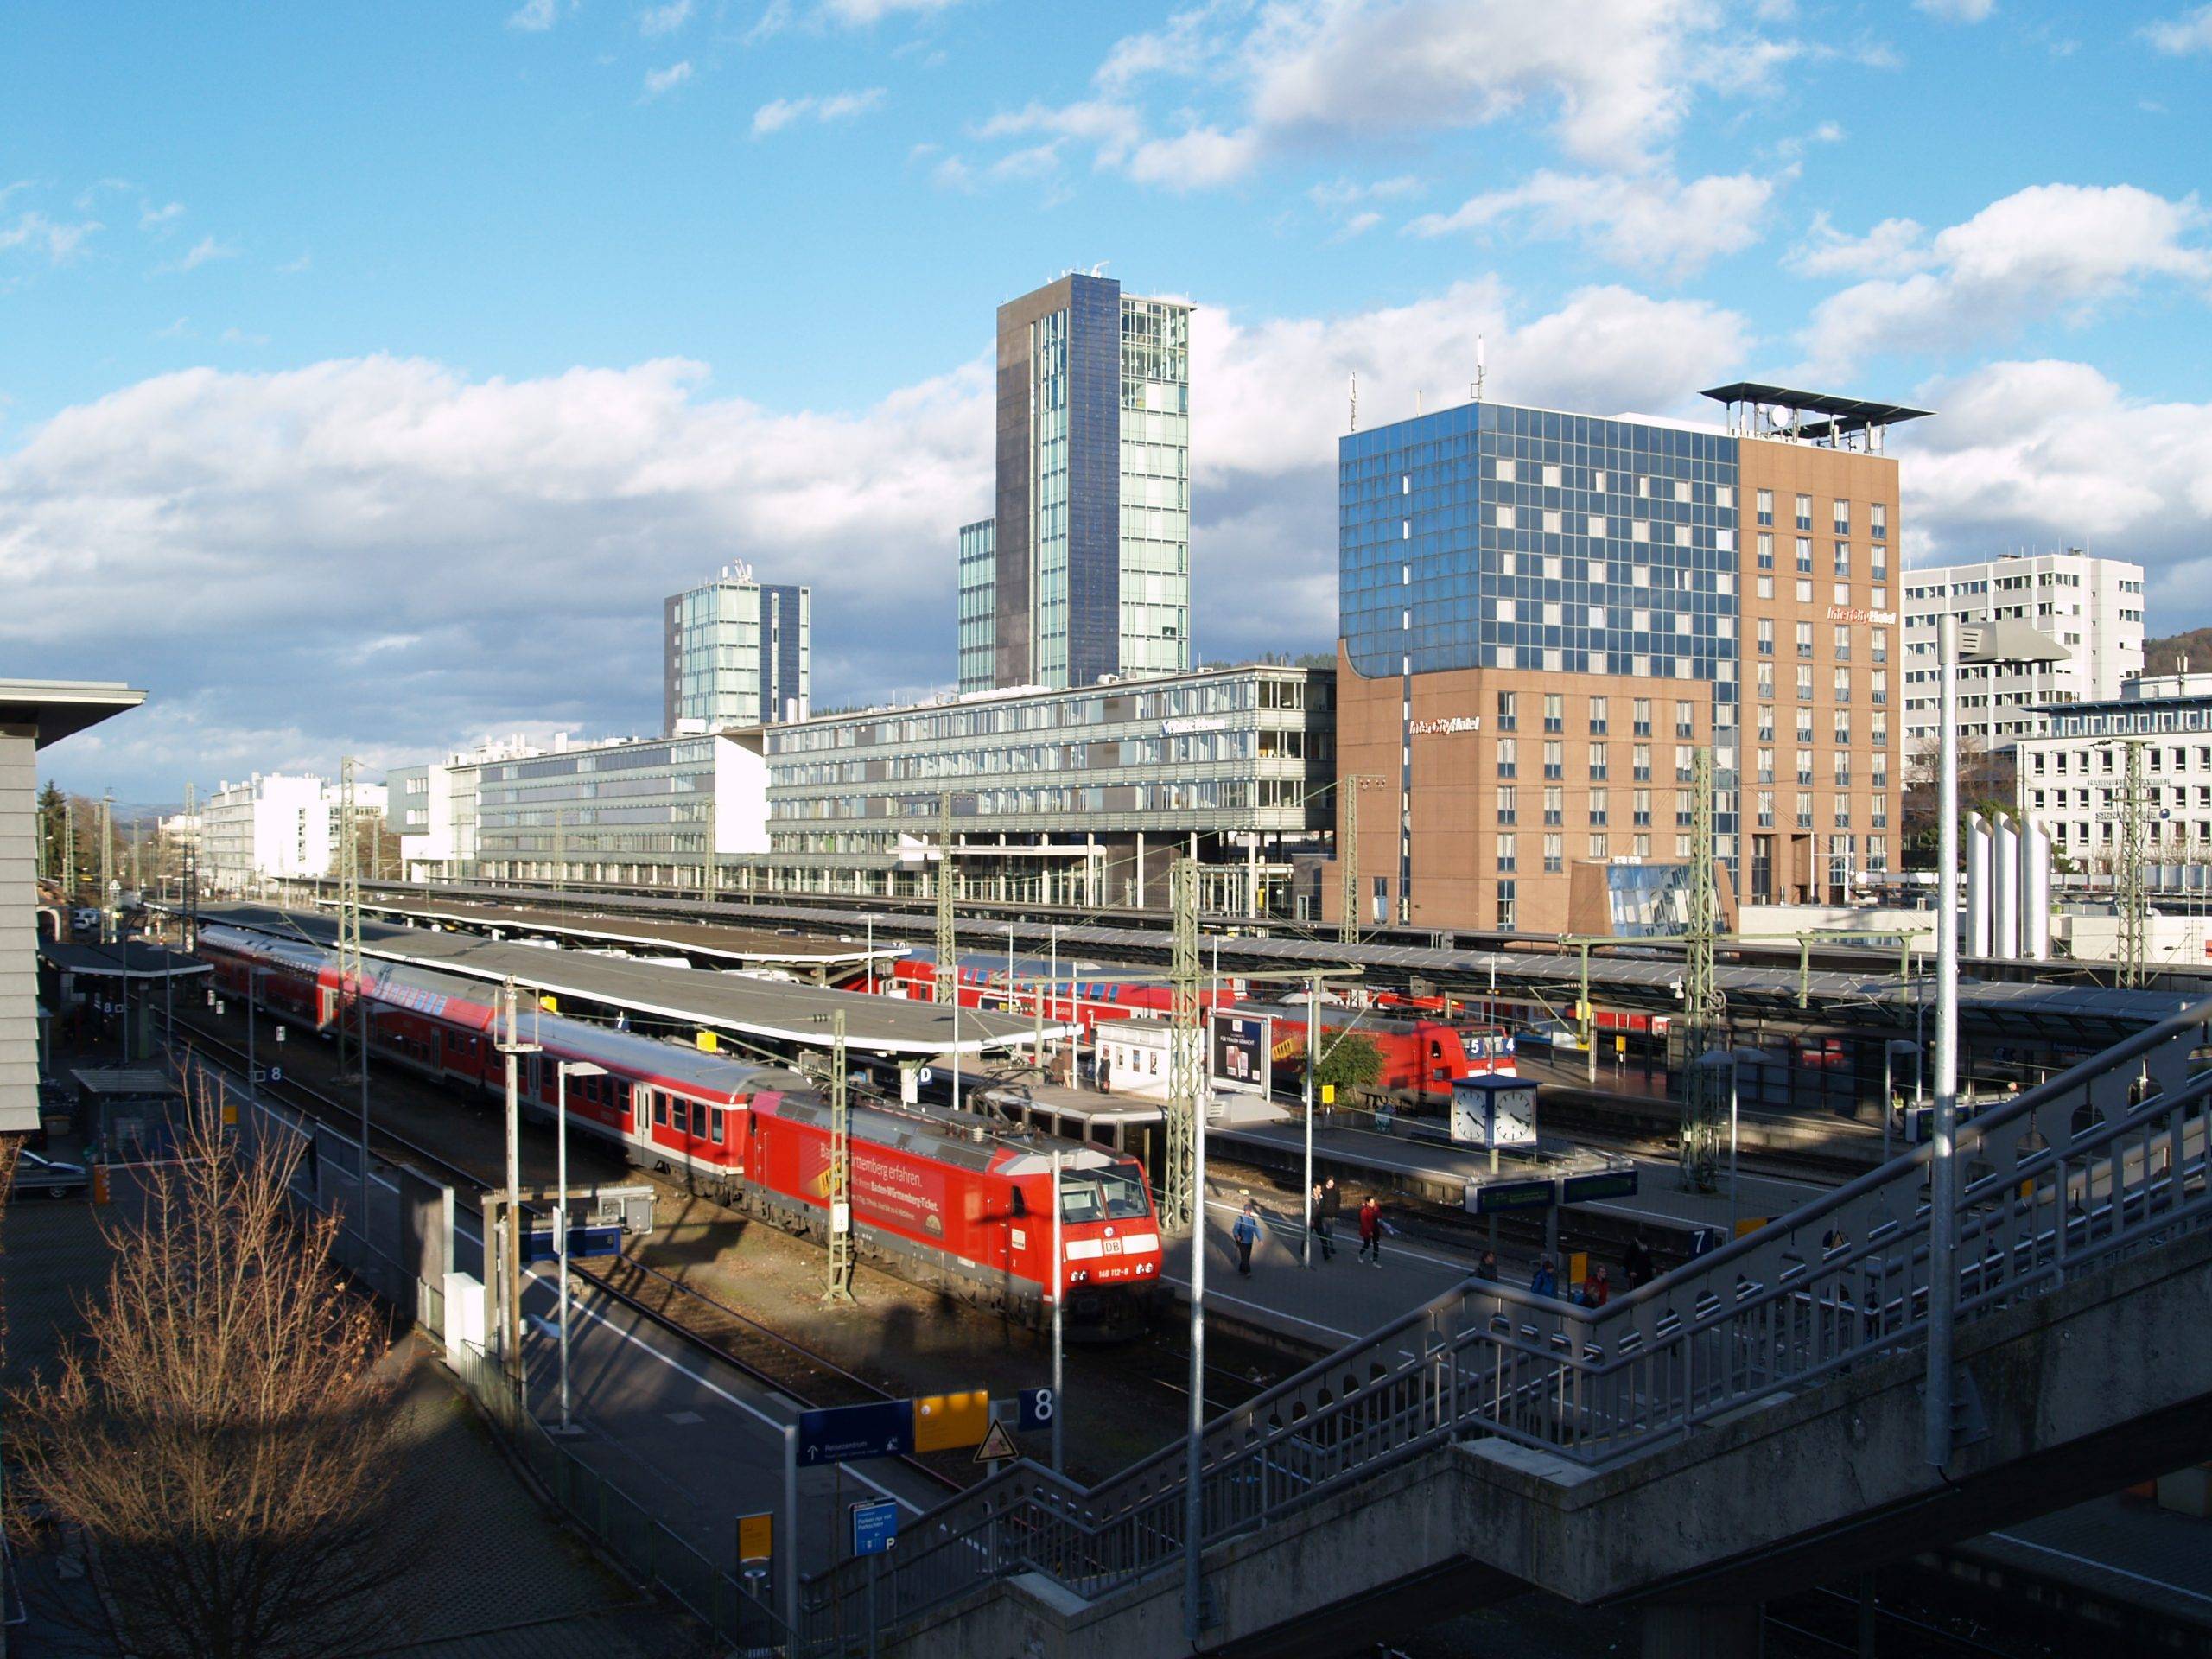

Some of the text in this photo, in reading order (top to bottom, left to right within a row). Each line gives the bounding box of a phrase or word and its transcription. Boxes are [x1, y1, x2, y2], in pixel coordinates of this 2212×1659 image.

[1827, 607, 1897, 626] InterCityHotel
[1409, 716, 1480, 734] InterCityHotel
[104, 1002, 111, 1013] 8
[1471, 1039, 1479, 1053] 5
[1506, 1038, 1515, 1051] 4
[270, 1067, 282, 1080] 8
[920, 1067, 931, 1082] D
[888, 1164, 923, 1188] erfahren.
[1105, 1241, 1121, 1253] DB
[1694, 1230, 1705, 1253] 7
[1035, 1389, 1052, 1420] 8
[825, 1441, 868, 1452] Reisezentrum
[887, 1537, 895, 1550] P
